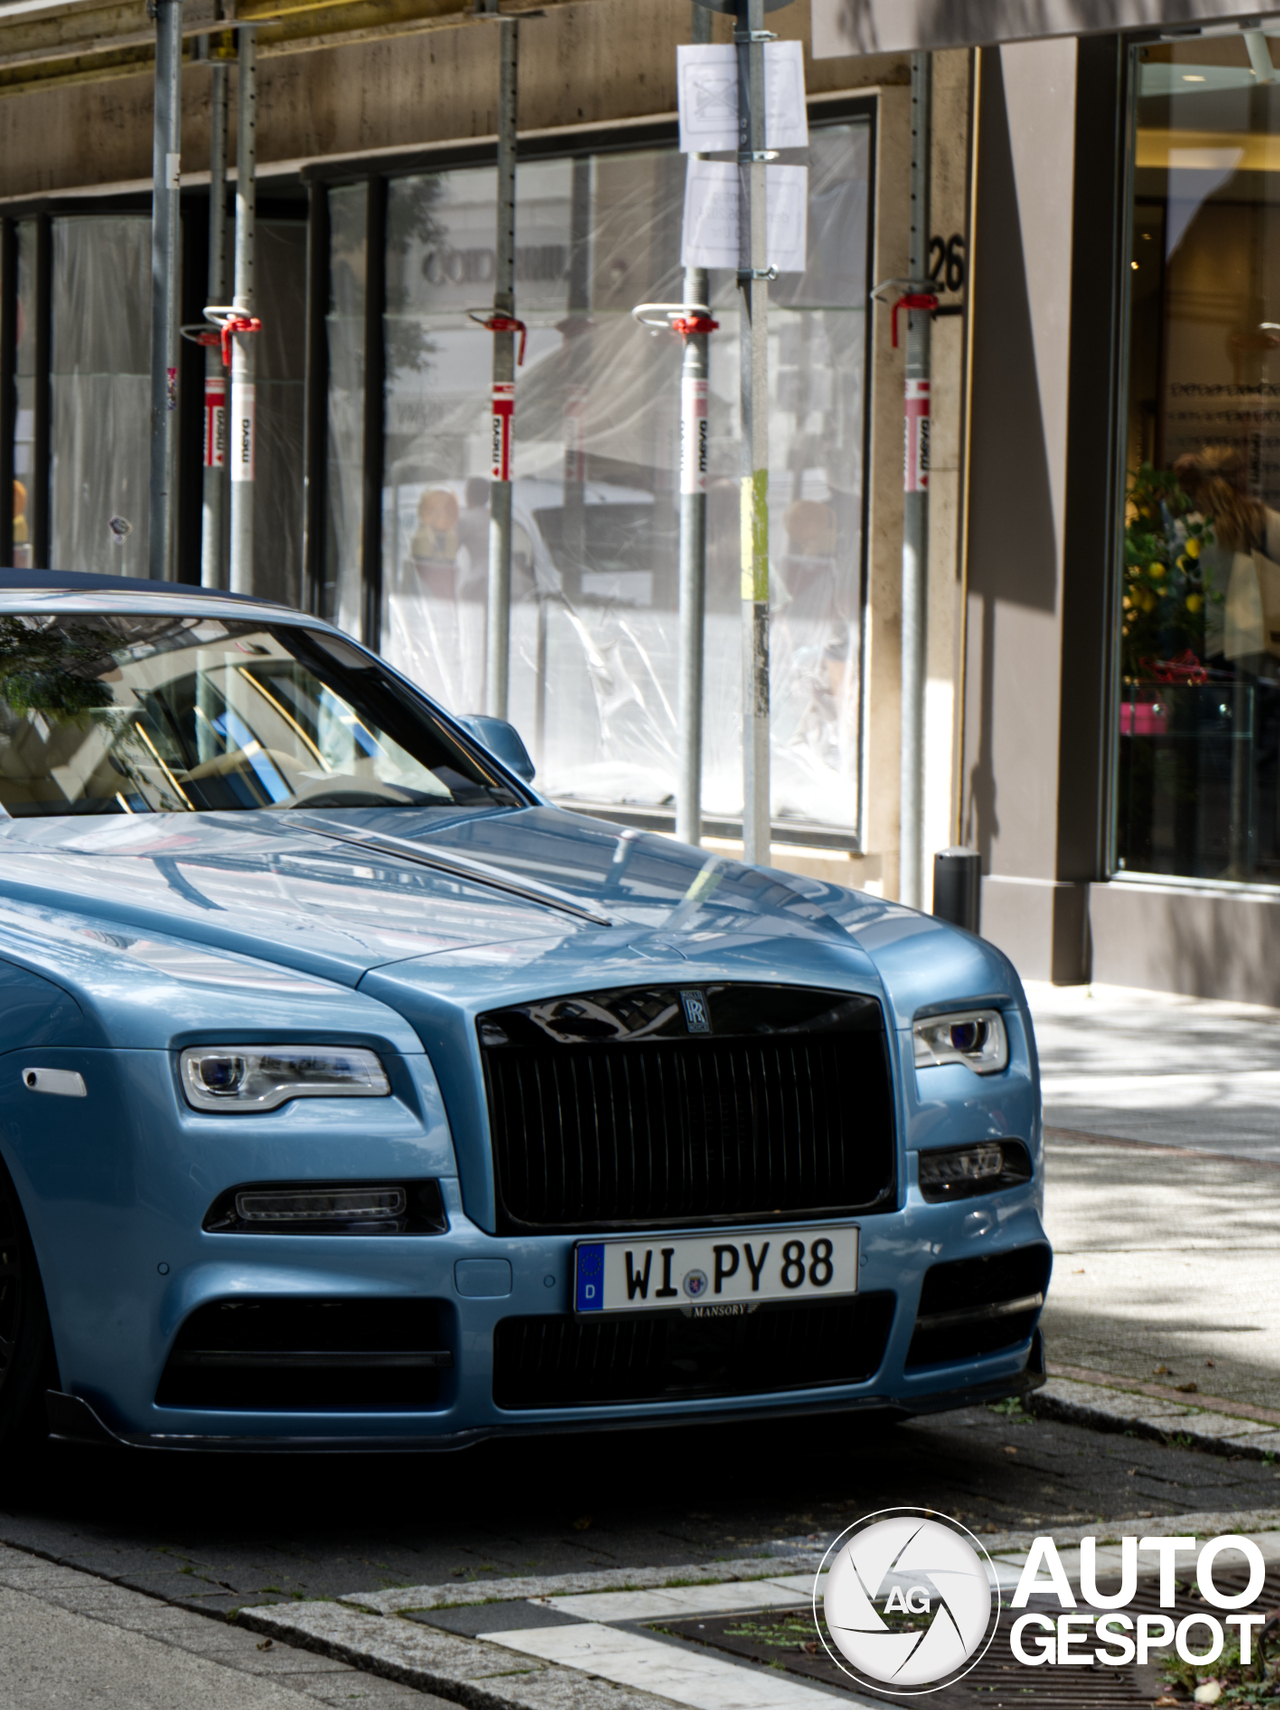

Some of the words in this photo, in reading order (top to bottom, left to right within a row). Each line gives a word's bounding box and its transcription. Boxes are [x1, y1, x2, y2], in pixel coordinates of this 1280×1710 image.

[929, 234, 964, 292] 26
[241, 419, 250, 463] meva
[492, 418, 500, 463] meva
[699, 420, 707, 472] meva
[920, 419, 929, 470] meva
[585, 1284, 595, 1299] D
[625, 1247, 678, 1300] WI
[713, 1241, 770, 1294] PY
[780, 1238, 834, 1289] 88
[694, 1303, 746, 1318] MANSORY
